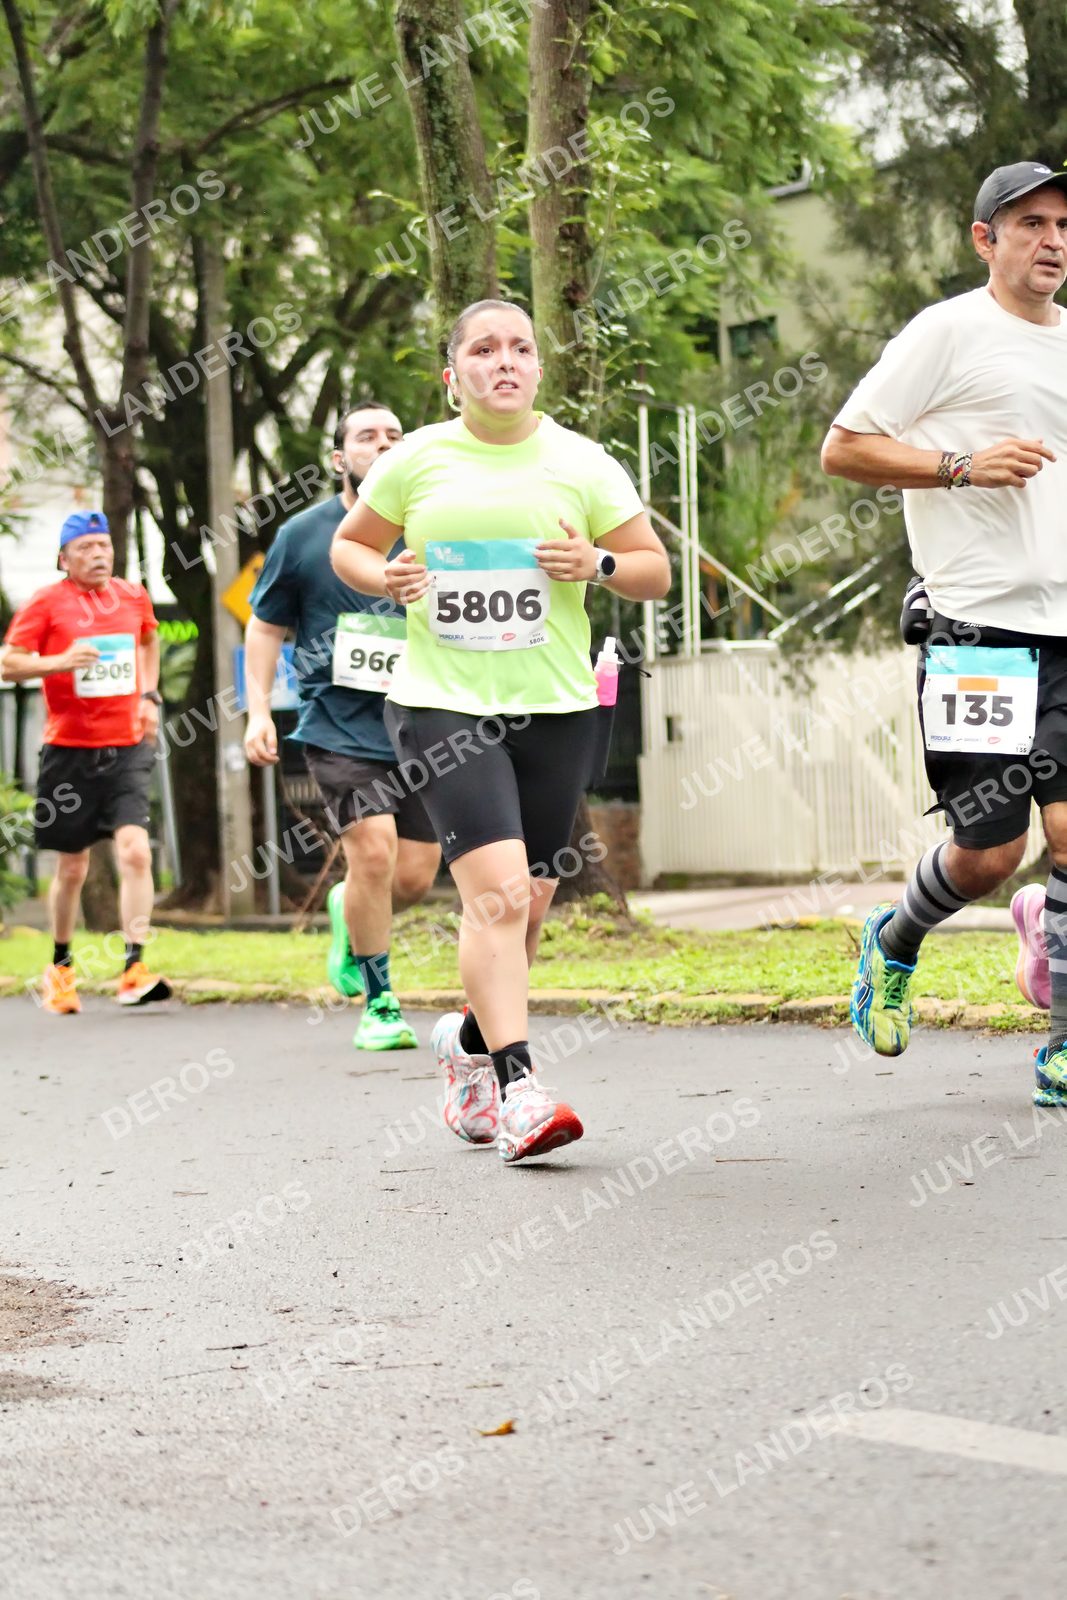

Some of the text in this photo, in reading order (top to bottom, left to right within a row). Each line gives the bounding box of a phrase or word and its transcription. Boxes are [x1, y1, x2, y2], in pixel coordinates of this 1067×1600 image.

[436, 588, 542, 624] 5806
[81, 662, 133, 682] 2909
[941, 693, 1014, 727] 135
